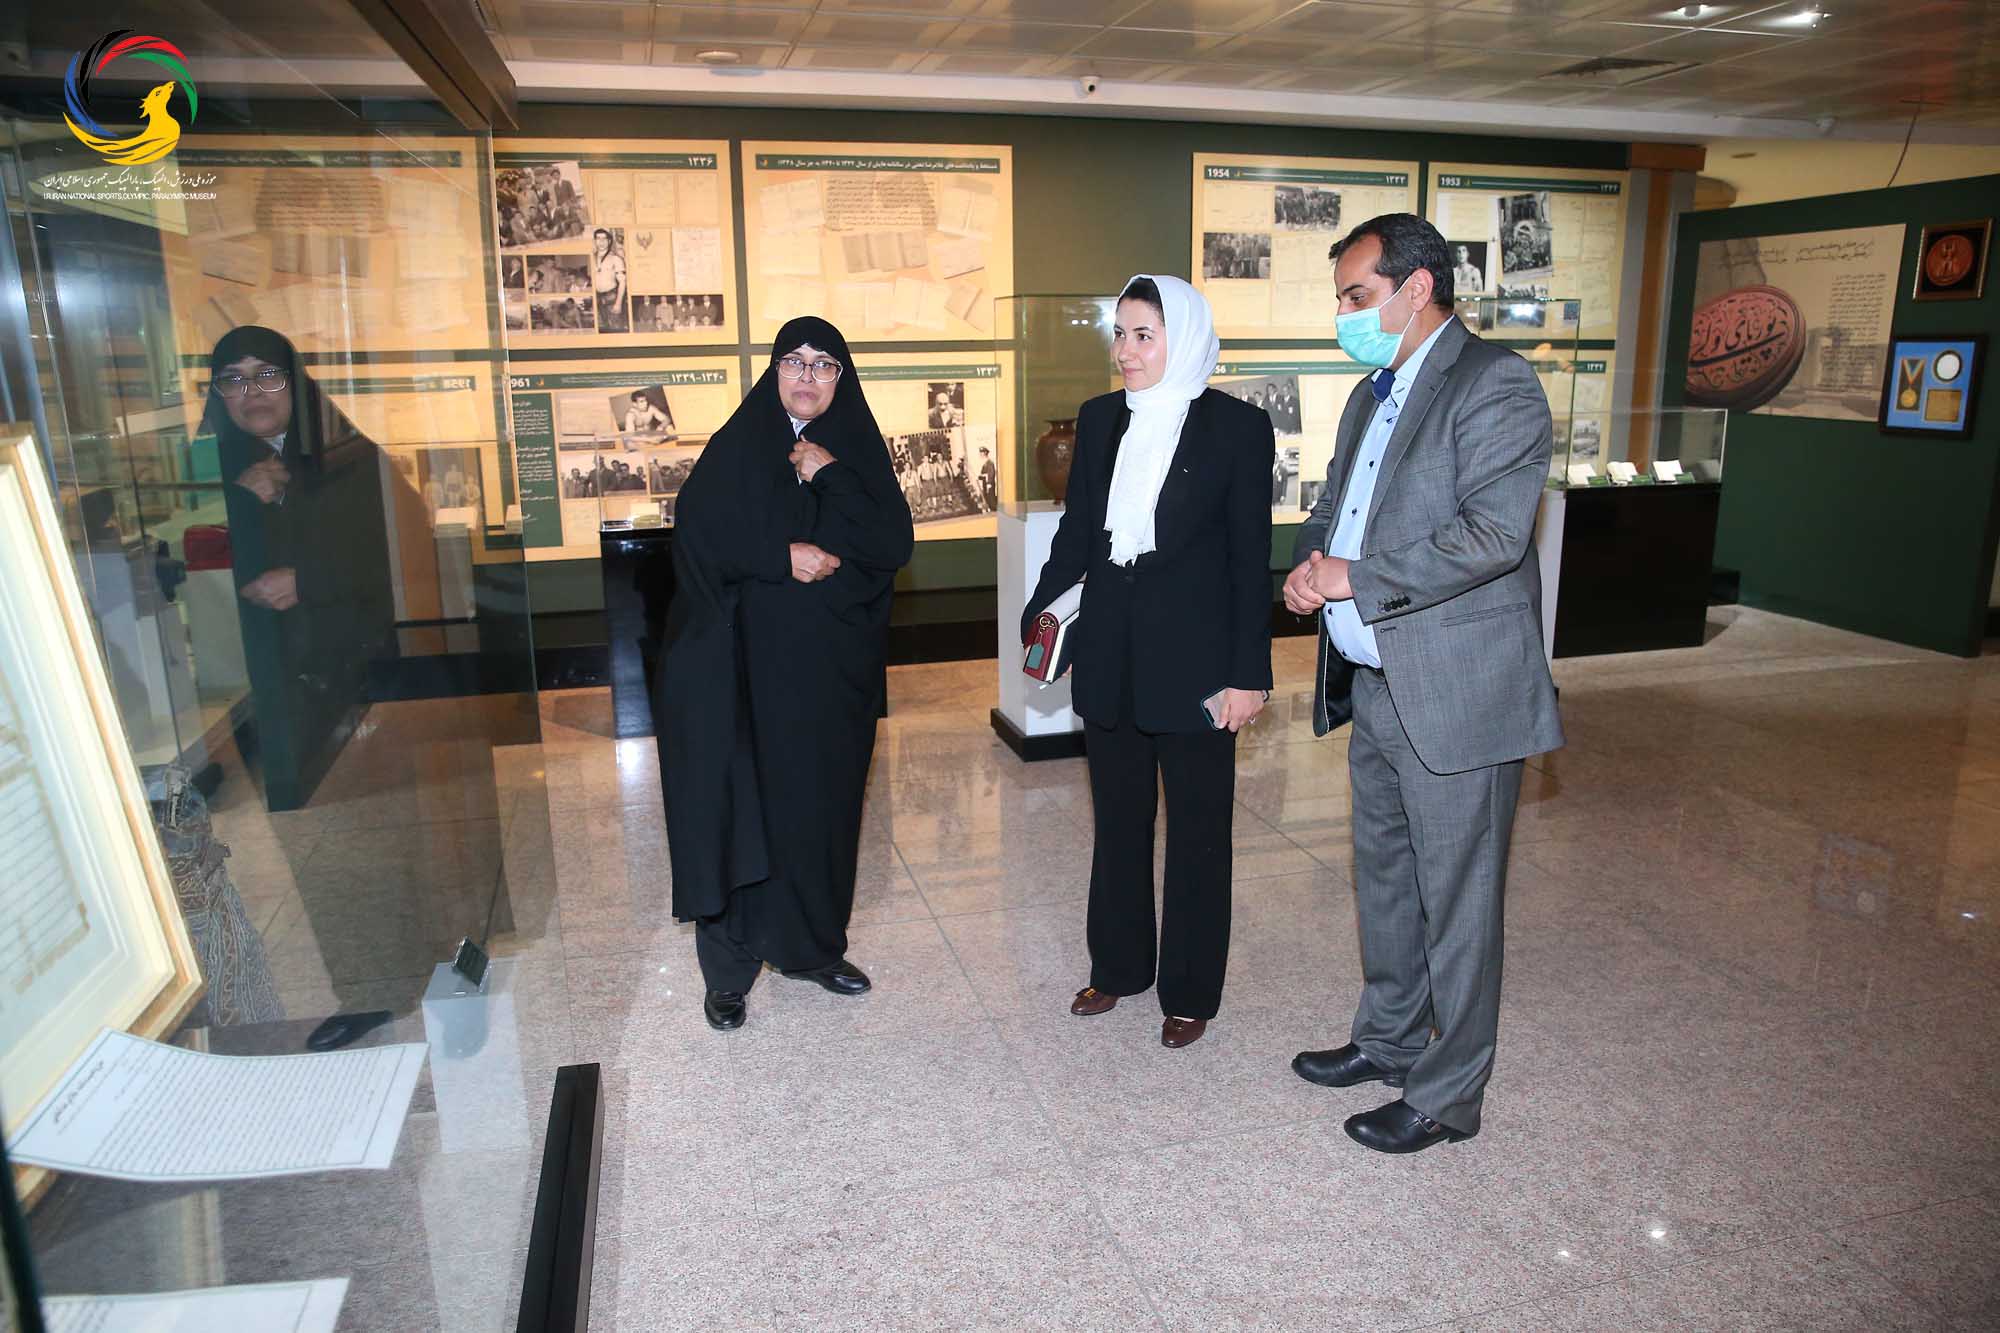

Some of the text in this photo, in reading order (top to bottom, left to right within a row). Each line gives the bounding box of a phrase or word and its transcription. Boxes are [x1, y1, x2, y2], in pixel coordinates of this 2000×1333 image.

[688, 156, 713, 167] ۱۳۳۶
[795, 159, 806, 168] سال
[855, 160, 866, 169] سال
[1207, 168, 1230, 178] 1954
[1441, 176, 1461, 187] 1953
[511, 377, 530, 389] 961
